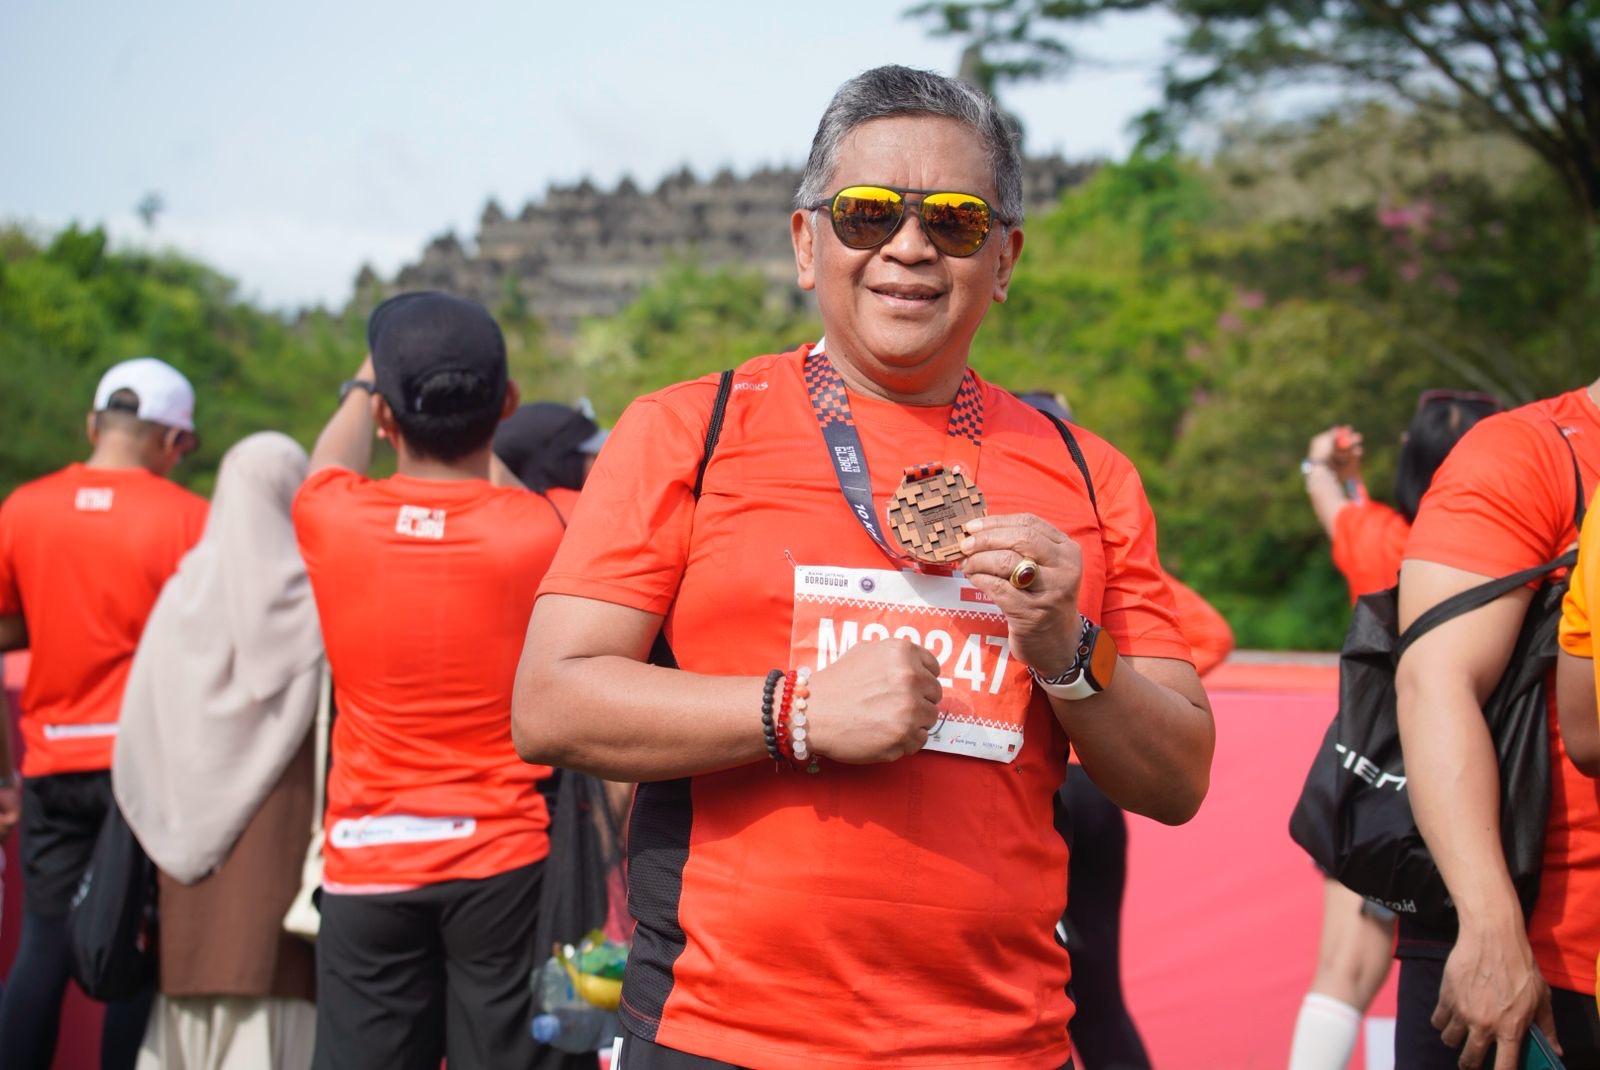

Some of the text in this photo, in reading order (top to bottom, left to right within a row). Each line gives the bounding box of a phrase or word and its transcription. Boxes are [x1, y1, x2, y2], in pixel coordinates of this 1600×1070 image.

[834, 446, 853, 473] GLORY
[854, 504, 870, 519] 10
[804, 575, 848, 587] BOROBUDUR
[975, 591, 982, 601] 10
